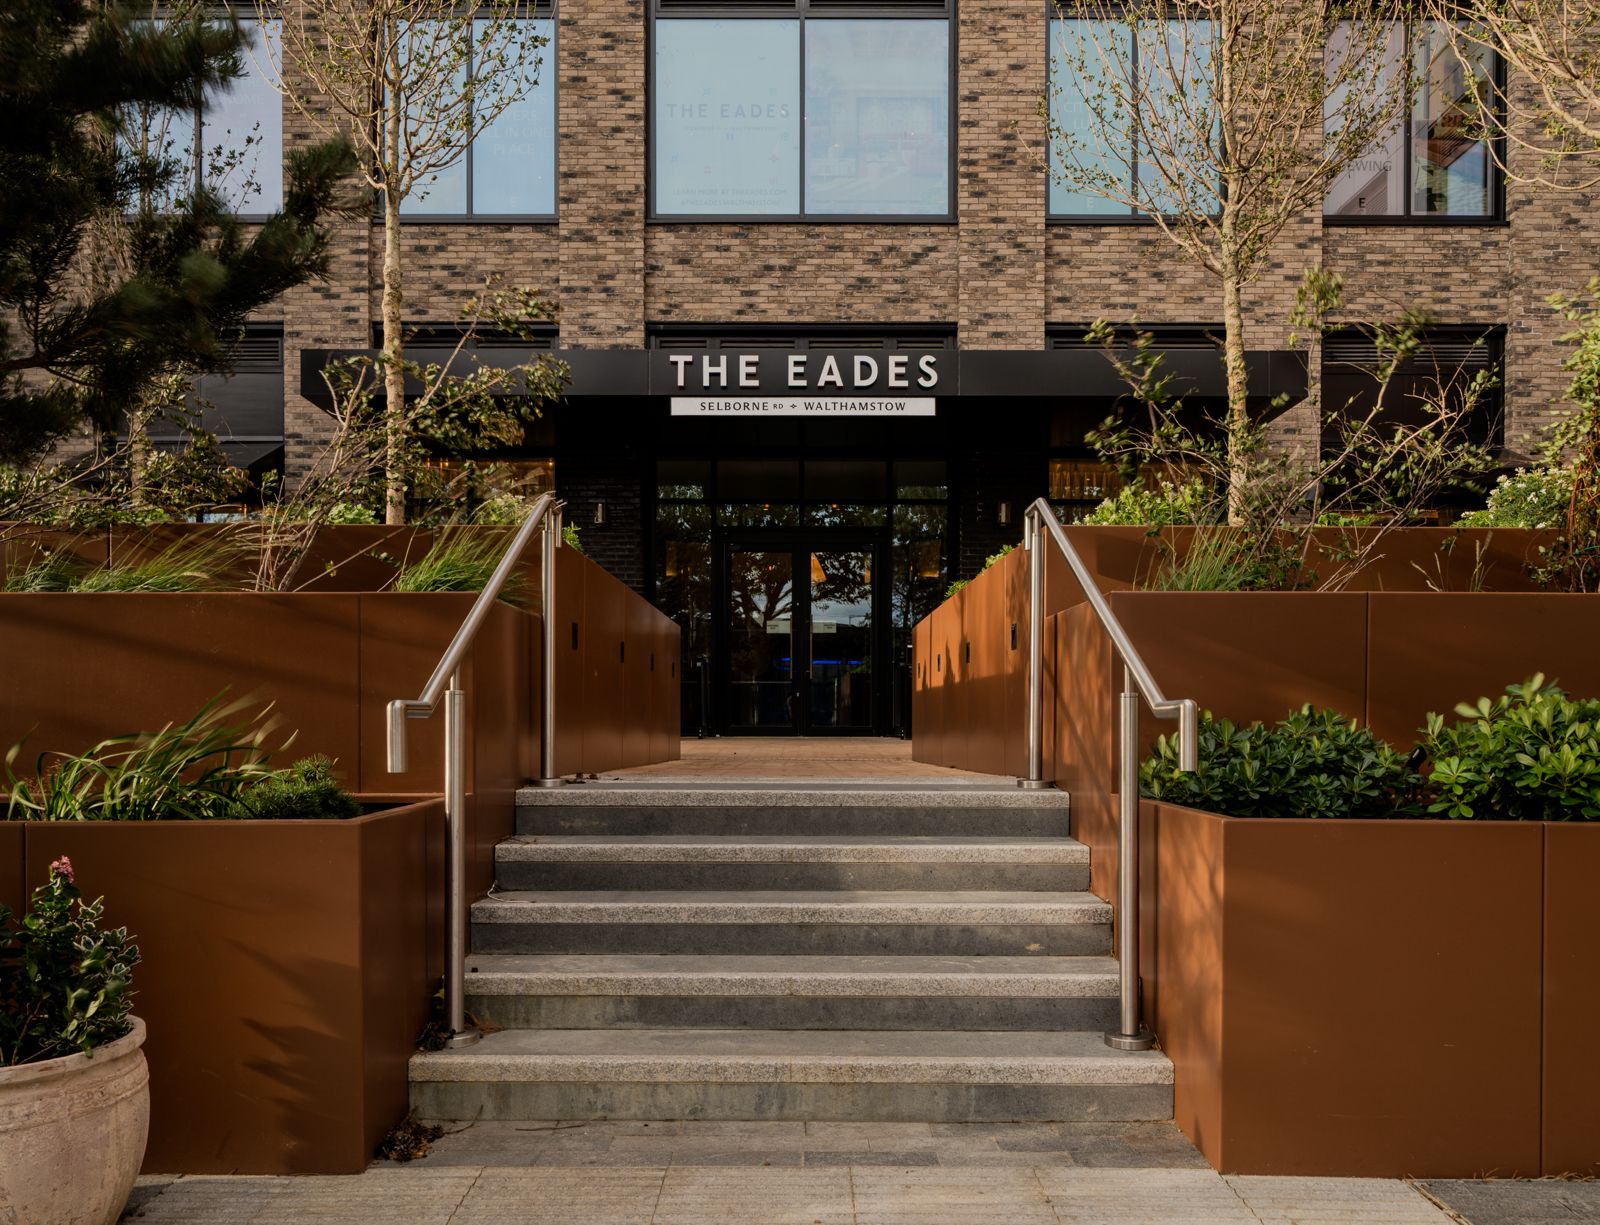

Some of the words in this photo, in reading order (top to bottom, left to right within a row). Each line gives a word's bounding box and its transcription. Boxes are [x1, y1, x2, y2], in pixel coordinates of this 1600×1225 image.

[666, 103, 708, 118] THE
[720, 103, 790, 118] EADES
[1359, 197, 1366, 208] E
[669, 355, 760, 387] THE
[788, 354, 938, 388] EADES
[700, 401, 769, 411] SELBORNE
[804, 401, 906, 411] WALTHAMSTOW
